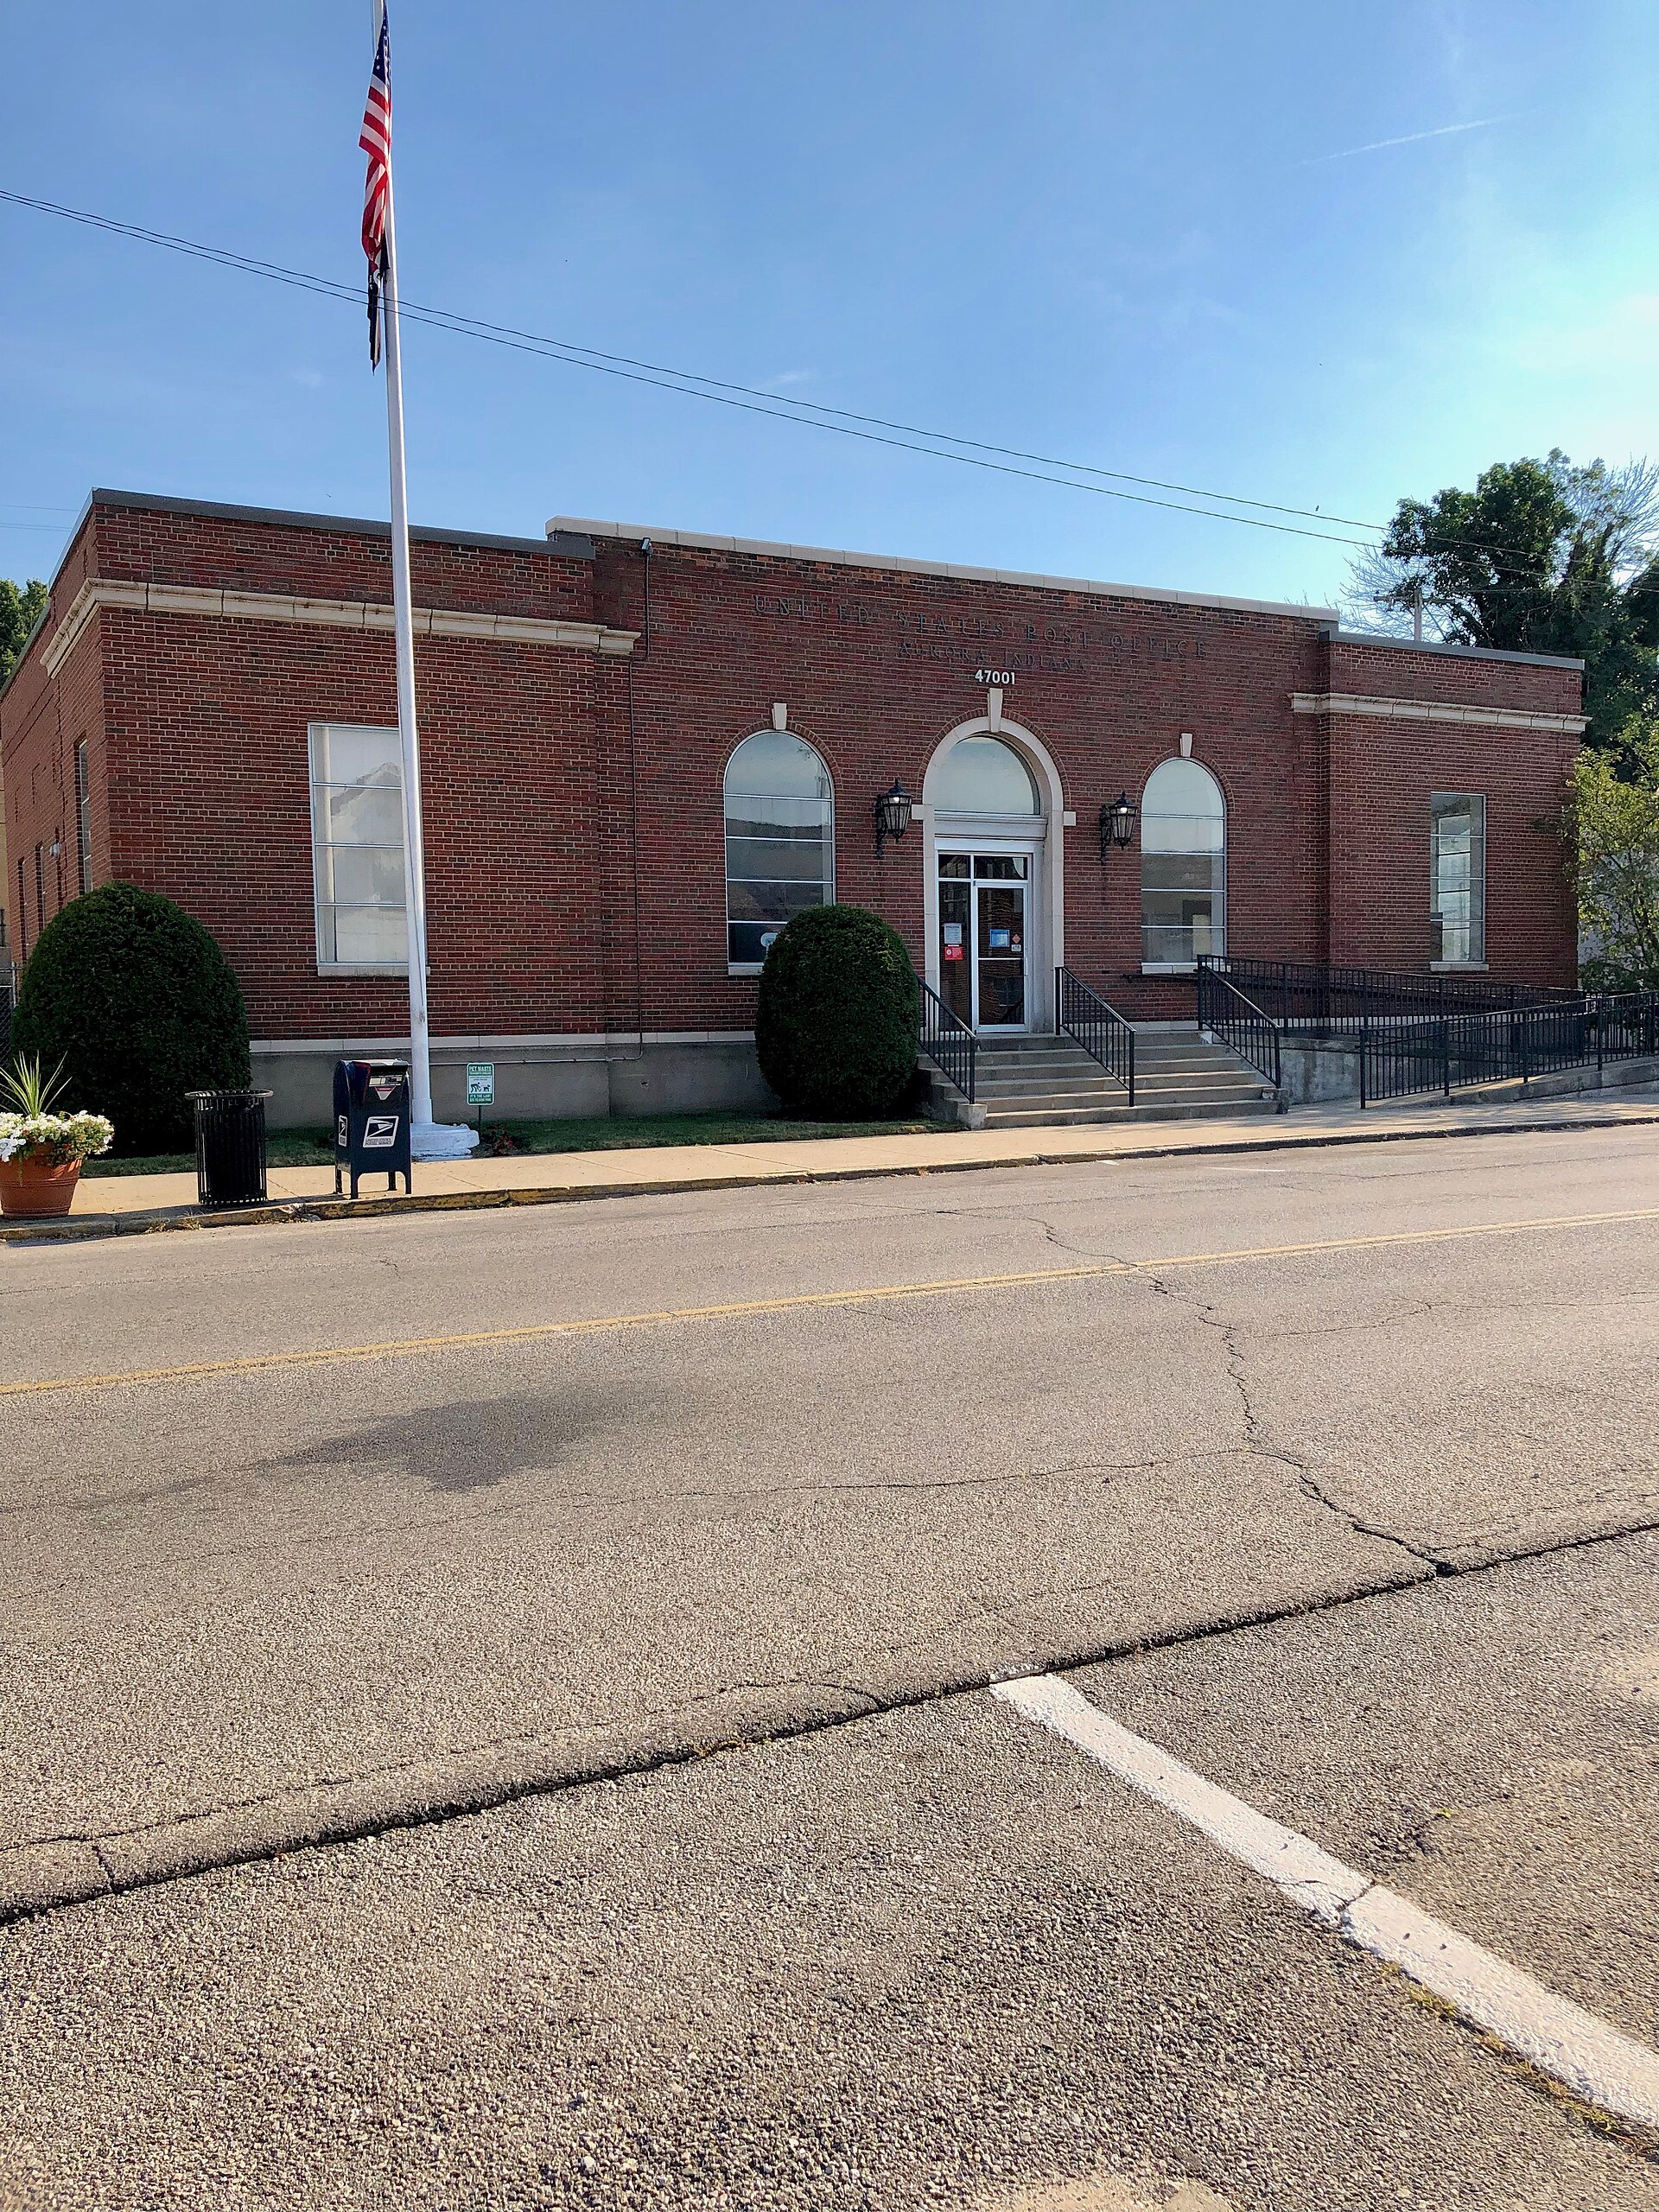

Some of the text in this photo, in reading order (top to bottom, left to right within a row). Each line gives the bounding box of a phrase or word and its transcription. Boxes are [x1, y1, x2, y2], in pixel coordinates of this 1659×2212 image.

[753, 594, 1205, 658] UNITED STATES POST OFFICE
[898, 642, 985, 664] AURORA
[975, 669, 1015, 685] 47001
